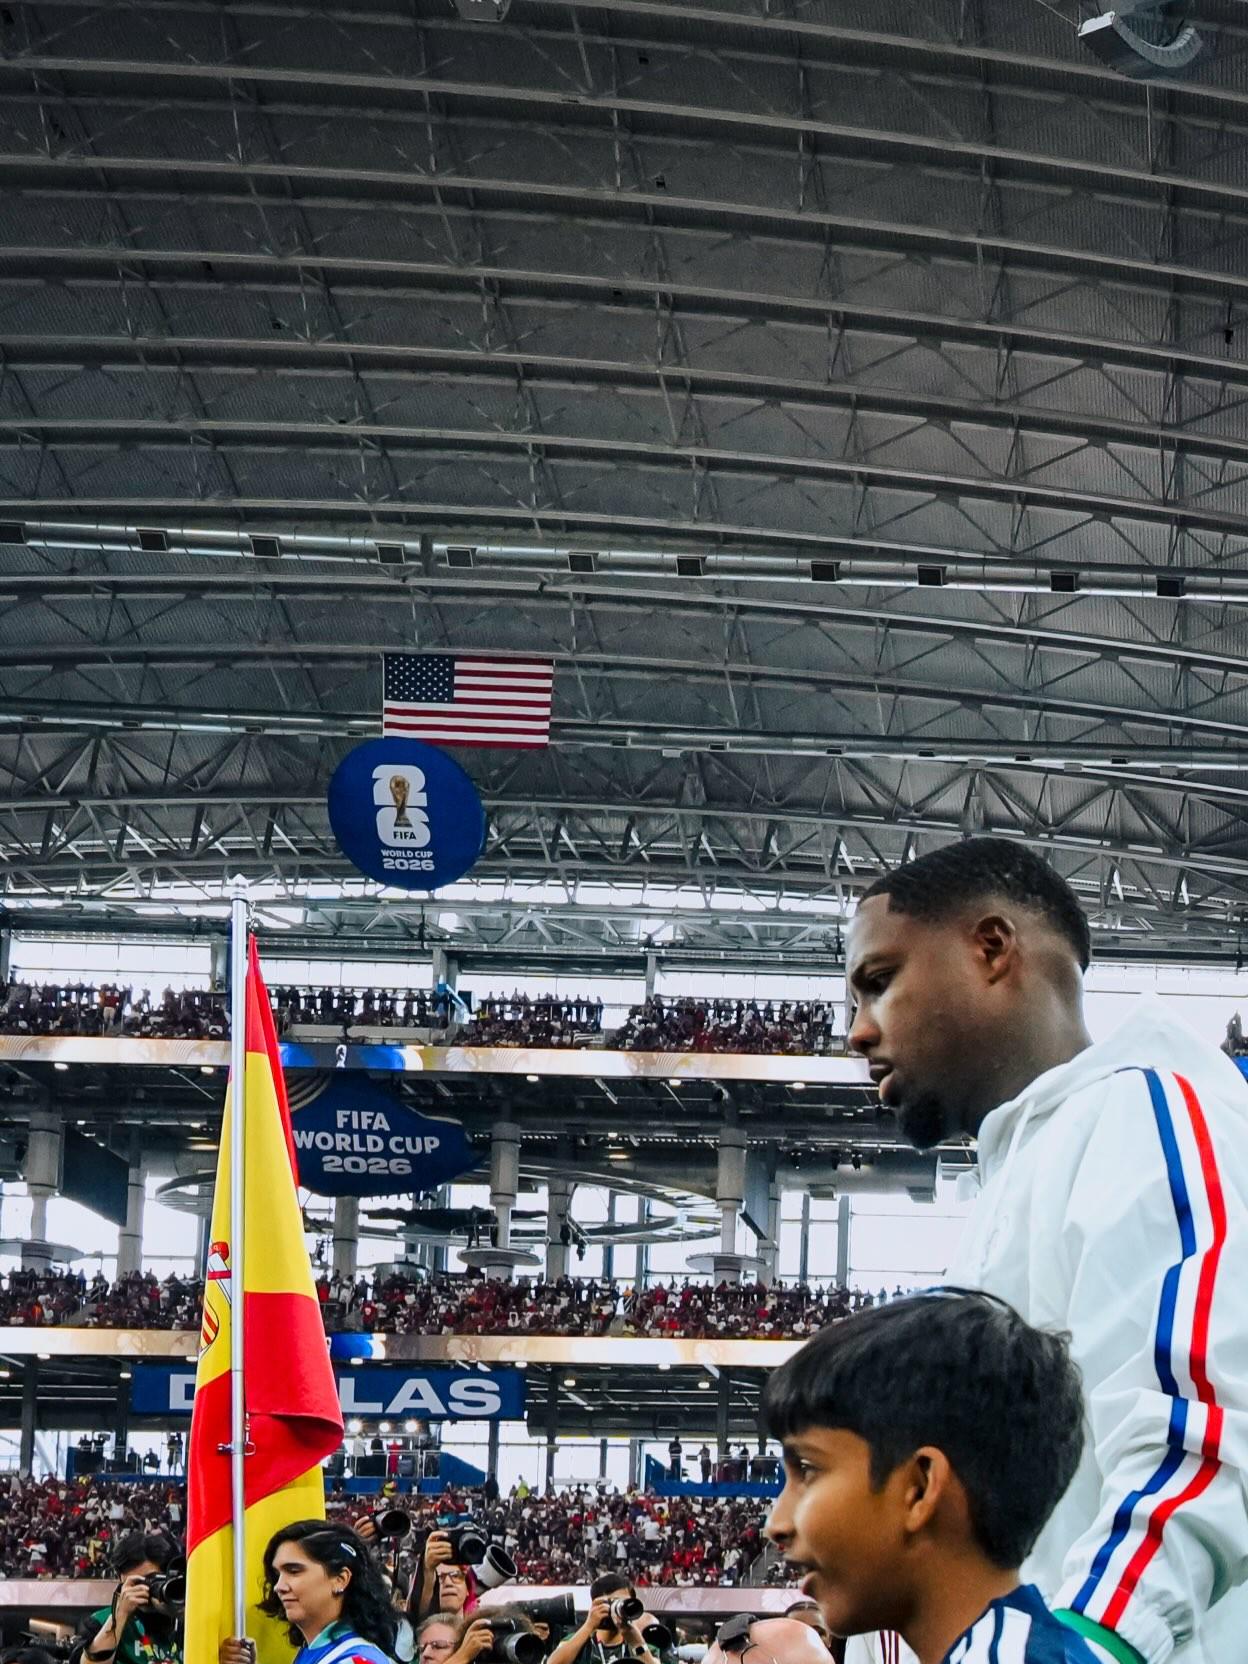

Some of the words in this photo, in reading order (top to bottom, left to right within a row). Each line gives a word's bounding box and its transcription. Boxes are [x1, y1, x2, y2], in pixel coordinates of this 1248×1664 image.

[393, 831, 417, 841] FIFA
[381, 849, 414, 858] WORLD
[415, 850, 434, 859] CUP
[382, 858, 435, 871] 2026
[336, 1110, 391, 1132] FIFA
[292, 1129, 385, 1153] WORLD
[388, 1135, 440, 1155] CUP
[321, 1155, 413, 1175] 2026
